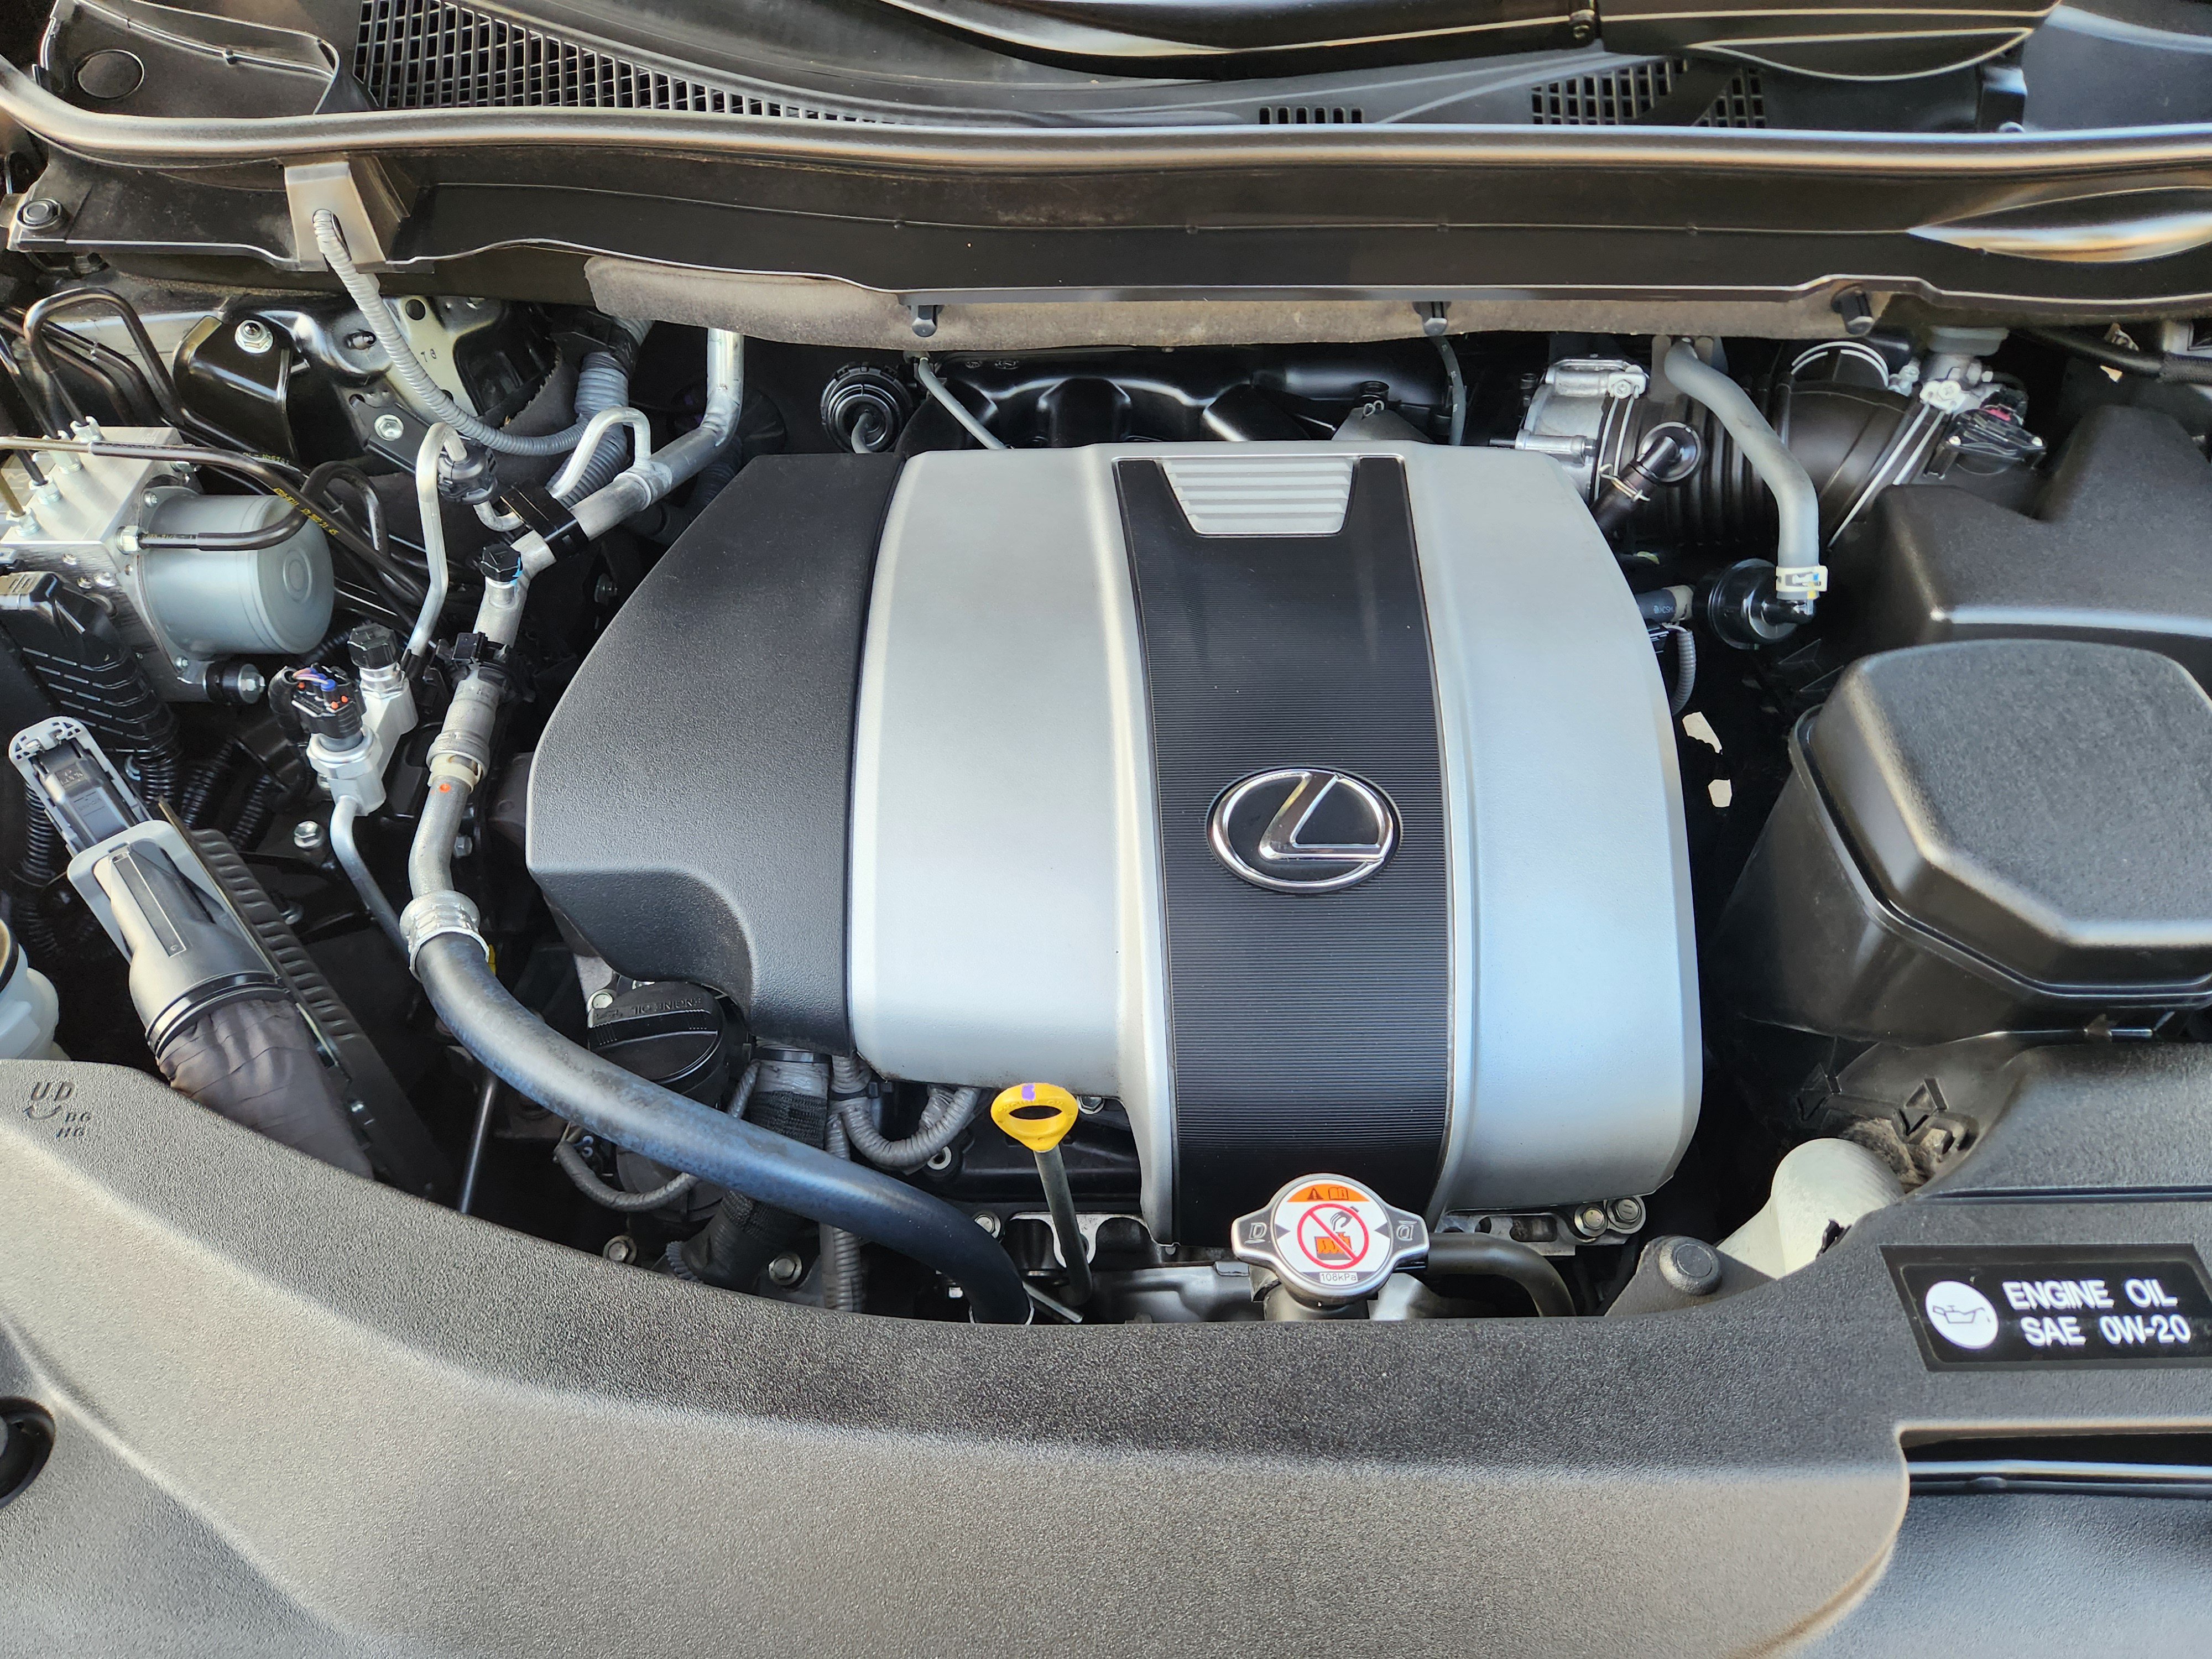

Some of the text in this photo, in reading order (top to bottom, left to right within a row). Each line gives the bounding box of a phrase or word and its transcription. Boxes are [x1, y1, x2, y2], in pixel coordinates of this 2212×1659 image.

[1321, 1273, 1357, 1281] 108kPa
[2002, 1278, 2178, 1310] ENGINE OIL
[2021, 1314, 2191, 1346] SAE 0W-20
